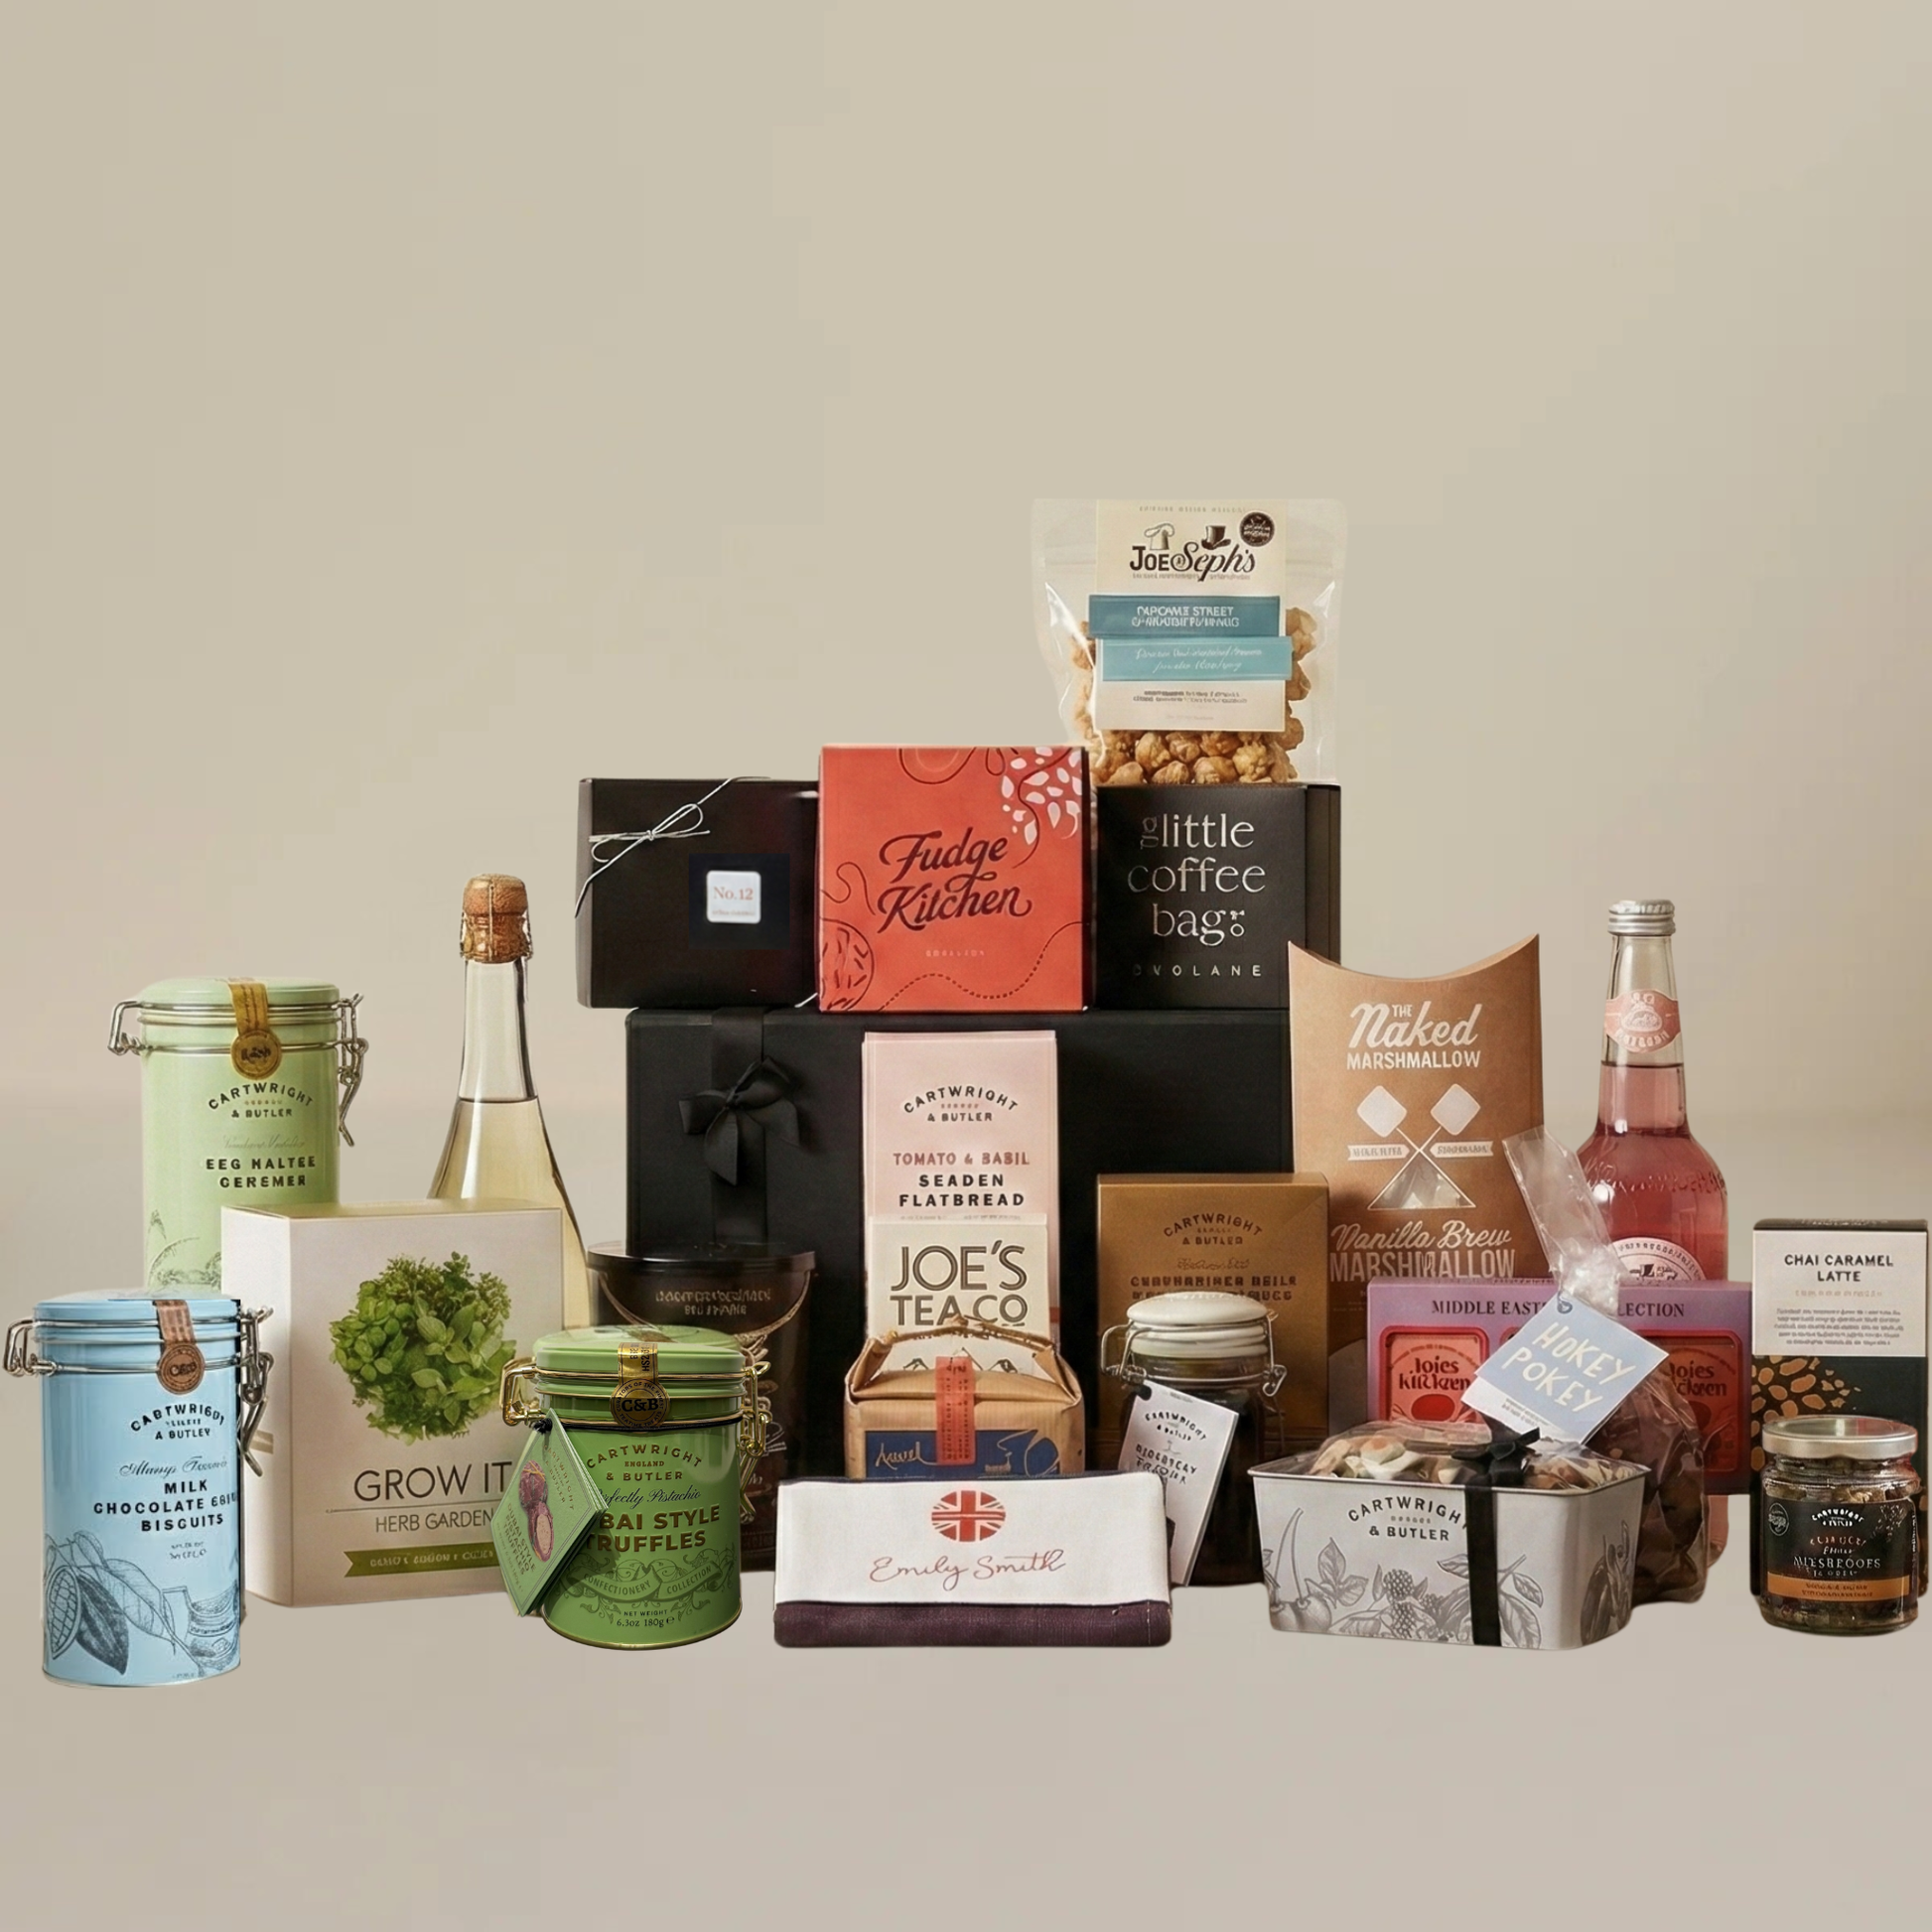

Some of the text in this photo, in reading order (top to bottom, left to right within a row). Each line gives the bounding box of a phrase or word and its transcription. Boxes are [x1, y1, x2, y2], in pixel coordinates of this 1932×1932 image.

[1130, 545, 1170, 571] JOE
[1193, 606, 1234, 617] STREET
[879, 827, 1008, 893] Fudge
[1128, 857, 1266, 893] coffee
[878, 882, 1033, 933] Kitchen
[1392, 1004, 1413, 1018] THE
[1349, 1001, 1483, 1048] Naked
[1347, 1050, 1481, 1070] MARSHMALLOW
[208, 1082, 313, 1110] CARTWRIGHT
[903, 1085, 1019, 1114] CARTWRIGHT
[245, 1109, 293, 1118] BUTLER
[942, 1112, 993, 1122] BUTLER
[206, 1158, 241, 1170] EEG
[893, 1153, 956, 1166] TOMATO
[918, 1174, 1005, 1187] SEADEN
[899, 1193, 1025, 1207] FLATBREAD
[1164, 1212, 1263, 1237] CARTWRIGHT
[1330, 1219, 1512, 1251] Vanilla Brew
[891, 1240, 1028, 1291] JOE'S
[1784, 1254, 1894, 1268] CHAI CARAMEL
[1817, 1271, 1862, 1282] LATTE
[890, 1294, 1029, 1327] TEA CO
[1432, 1301, 1496, 1314] MIDDLE
[1501, 1301, 1547, 1315] EAST
[1532, 1321, 1636, 1385] HOKEY
[1501, 1346, 1603, 1412] POKEY
[621, 1398, 659, 1412] C&B
[587, 1444, 702, 1469] CARTWRIGHT
[164, 1478, 207, 1494] MILK
[353, 1463, 473, 1501] GROW
[484, 1460, 512, 1494] IT
[606, 1471, 683, 1481] & BUTLER
[93, 1497, 205, 1515] CHOCOLATE
[599, 1485, 702, 1510] rfectly Pistachio
[141, 1513, 223, 1532] BISCUITS
[375, 1514, 420, 1533] HERB
[653, 1503, 720, 1530] STYLE
[1348, 1496, 1467, 1530] CARTWRIGH
[587, 1530, 706, 1553] TRUFFLES
[1369, 1525, 1449, 1541] & BUTLER
[583, 1566, 712, 1596] CONFECTIONERY COLLECTION
[870, 1549, 1066, 1591] Emily Smith
[617, 1618, 640, 1627] 6.3oz
[643, 1618, 664, 1628] 180g
